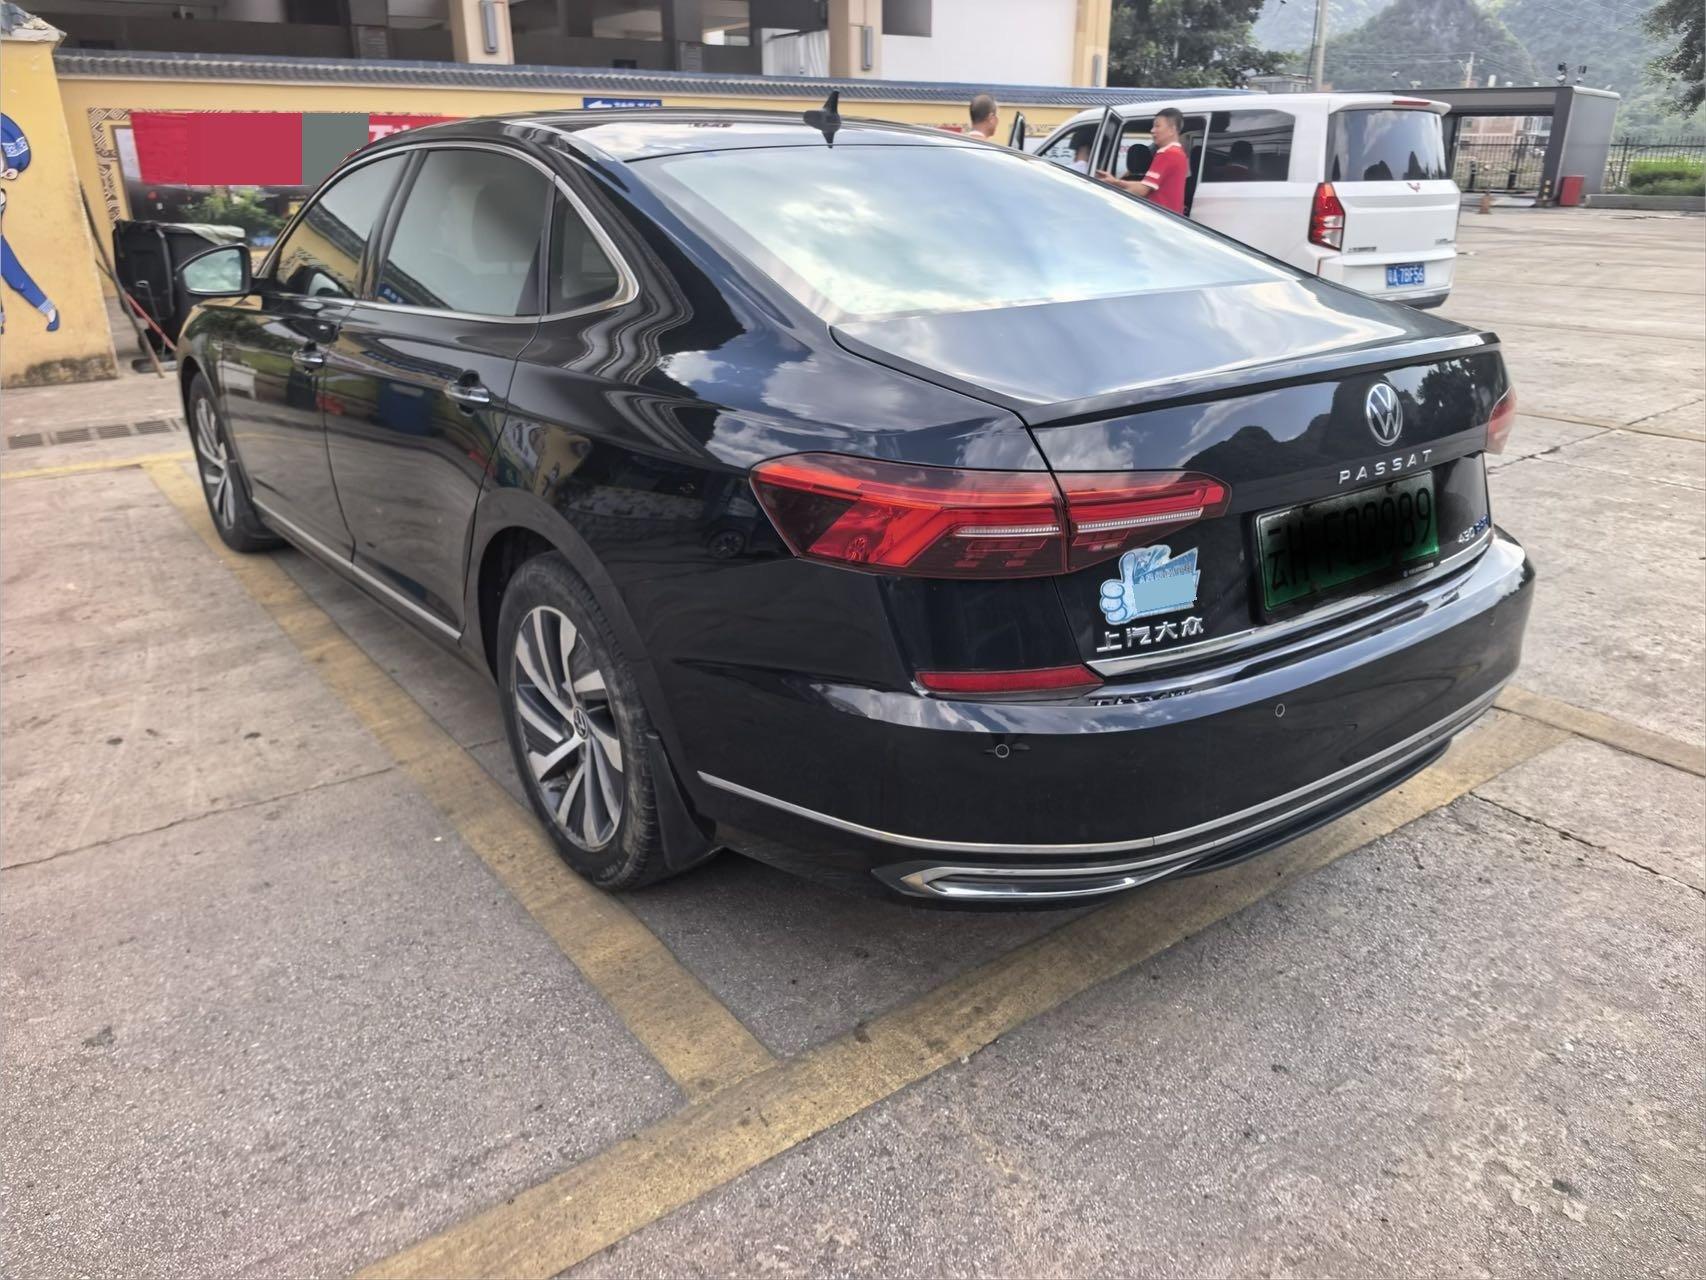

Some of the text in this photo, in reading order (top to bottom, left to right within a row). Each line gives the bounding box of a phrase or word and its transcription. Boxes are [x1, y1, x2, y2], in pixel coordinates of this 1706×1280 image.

[1338, 449, 1433, 485] PASSAT
[1096, 615, 1205, 653] 上汽大众
